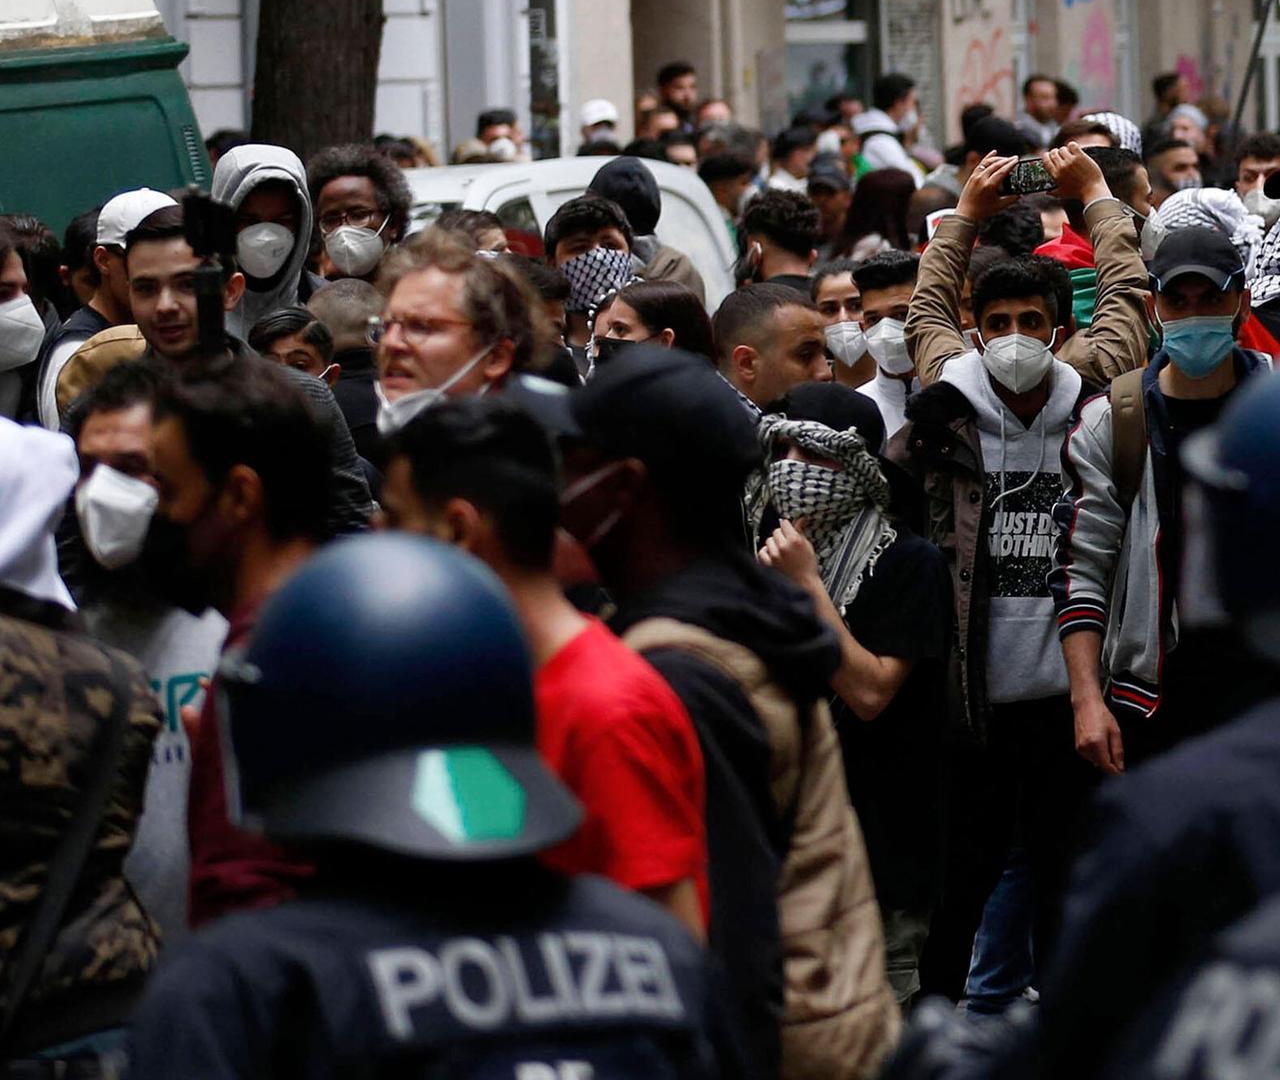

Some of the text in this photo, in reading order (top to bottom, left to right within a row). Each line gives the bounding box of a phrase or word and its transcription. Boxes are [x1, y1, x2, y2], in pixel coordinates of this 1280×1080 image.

[989, 512, 1037, 534] JUST
[988, 533, 1056, 558] NOTHIN
[367, 929, 686, 1041] POLIZEI
